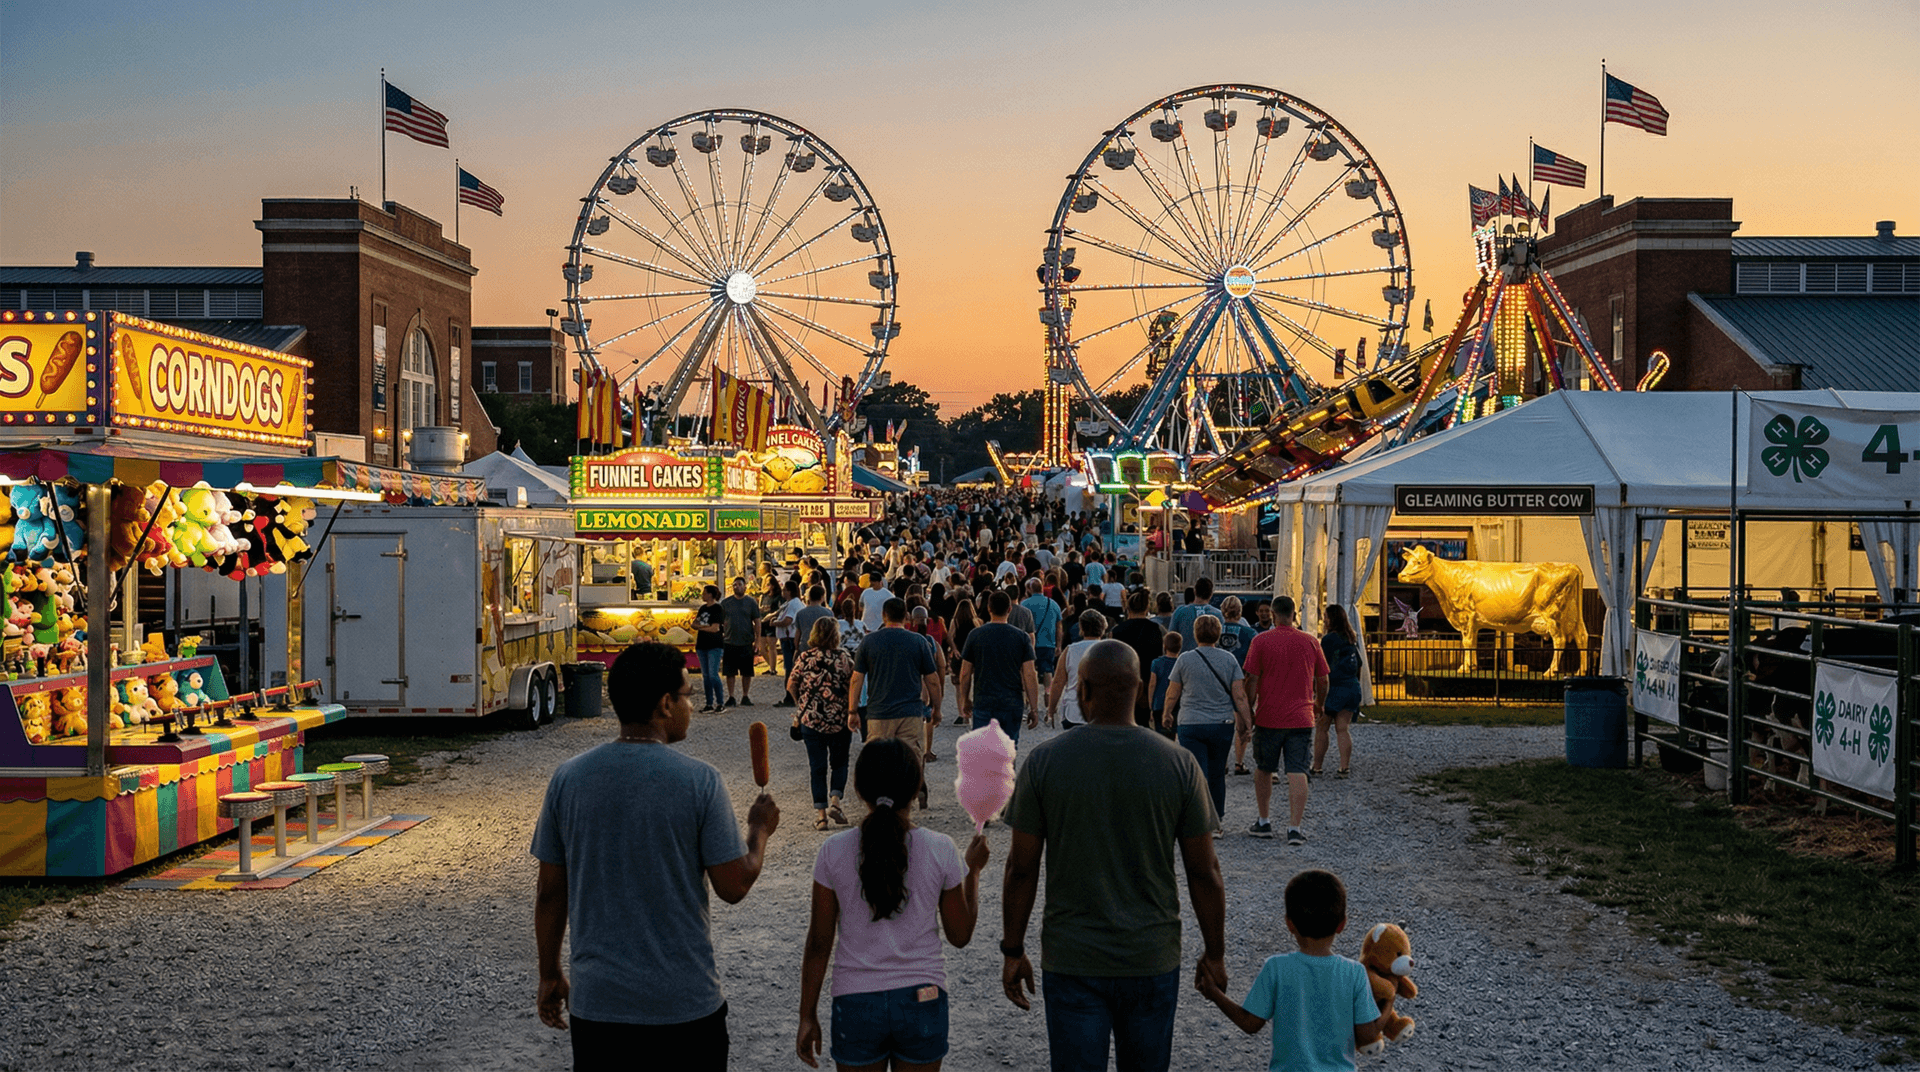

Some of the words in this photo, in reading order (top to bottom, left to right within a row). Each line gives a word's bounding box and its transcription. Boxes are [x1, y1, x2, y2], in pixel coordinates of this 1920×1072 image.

[150, 343, 284, 427] CORNDOGS
[791, 433, 820, 453] CAKES
[589, 465, 649, 488] FUNNEL
[652, 465, 703, 488] CAKES
[1404, 494, 1483, 507] GLEAMING
[1487, 494, 1545, 507] BUTTER
[1548, 494, 1584, 507] COW
[579, 512, 706, 529] LEMONADE
[1838, 700, 1868, 725] DAIRY
[1839, 727, 1861, 756] 4-H
